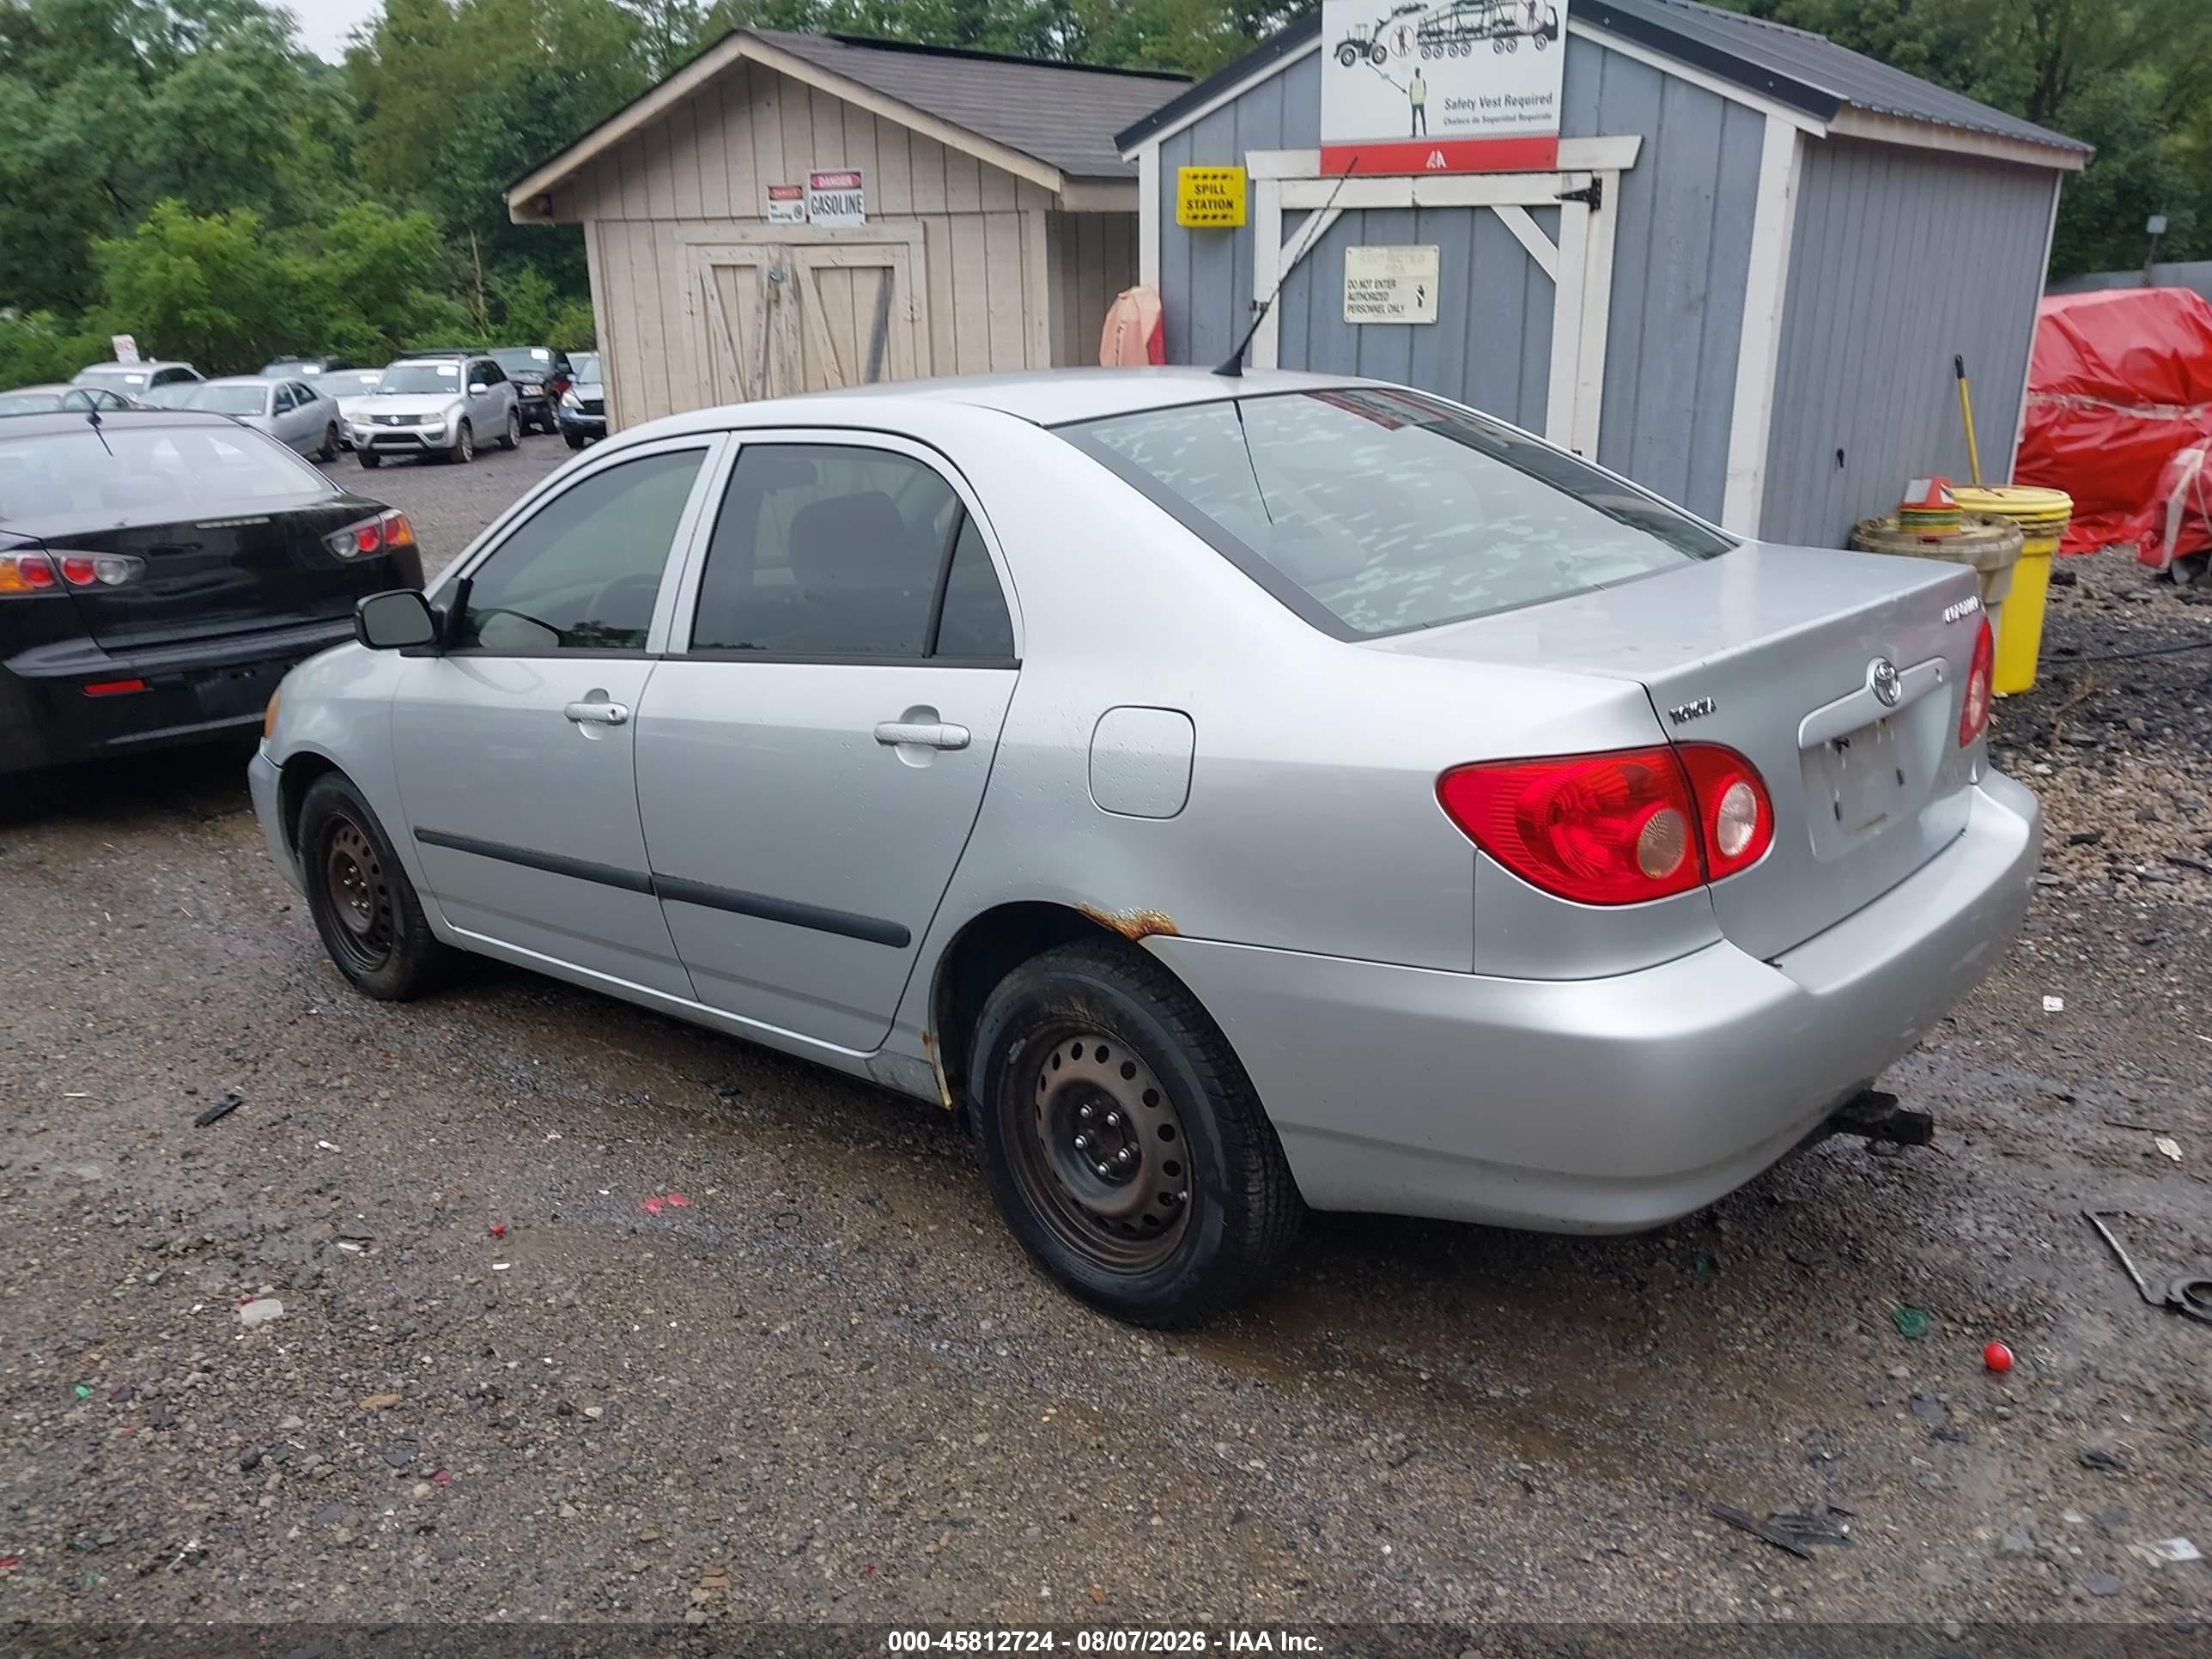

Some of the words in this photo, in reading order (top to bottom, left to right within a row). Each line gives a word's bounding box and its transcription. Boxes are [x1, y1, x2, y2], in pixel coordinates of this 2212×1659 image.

[1444, 95, 1476, 112] Safety
[1479, 94, 1502, 109] Vest
[1504, 89, 1553, 109] Required
[818, 174, 853, 188] DANGER
[1194, 183, 1227, 196] SPILL
[811, 193, 864, 216] GASOLINE
[1187, 198, 1235, 211] STATION
[1347, 278, 1358, 289] DO
[1359, 278, 1373, 289] NOT
[1374, 276, 1397, 289] ENTER
[1347, 290, 1390, 301] AUTHORIZED
[1347, 302, 1386, 314] PERSONNEL
[1387, 302, 1407, 314] ONLY
[1668, 696, 1717, 726] TOYOTA
